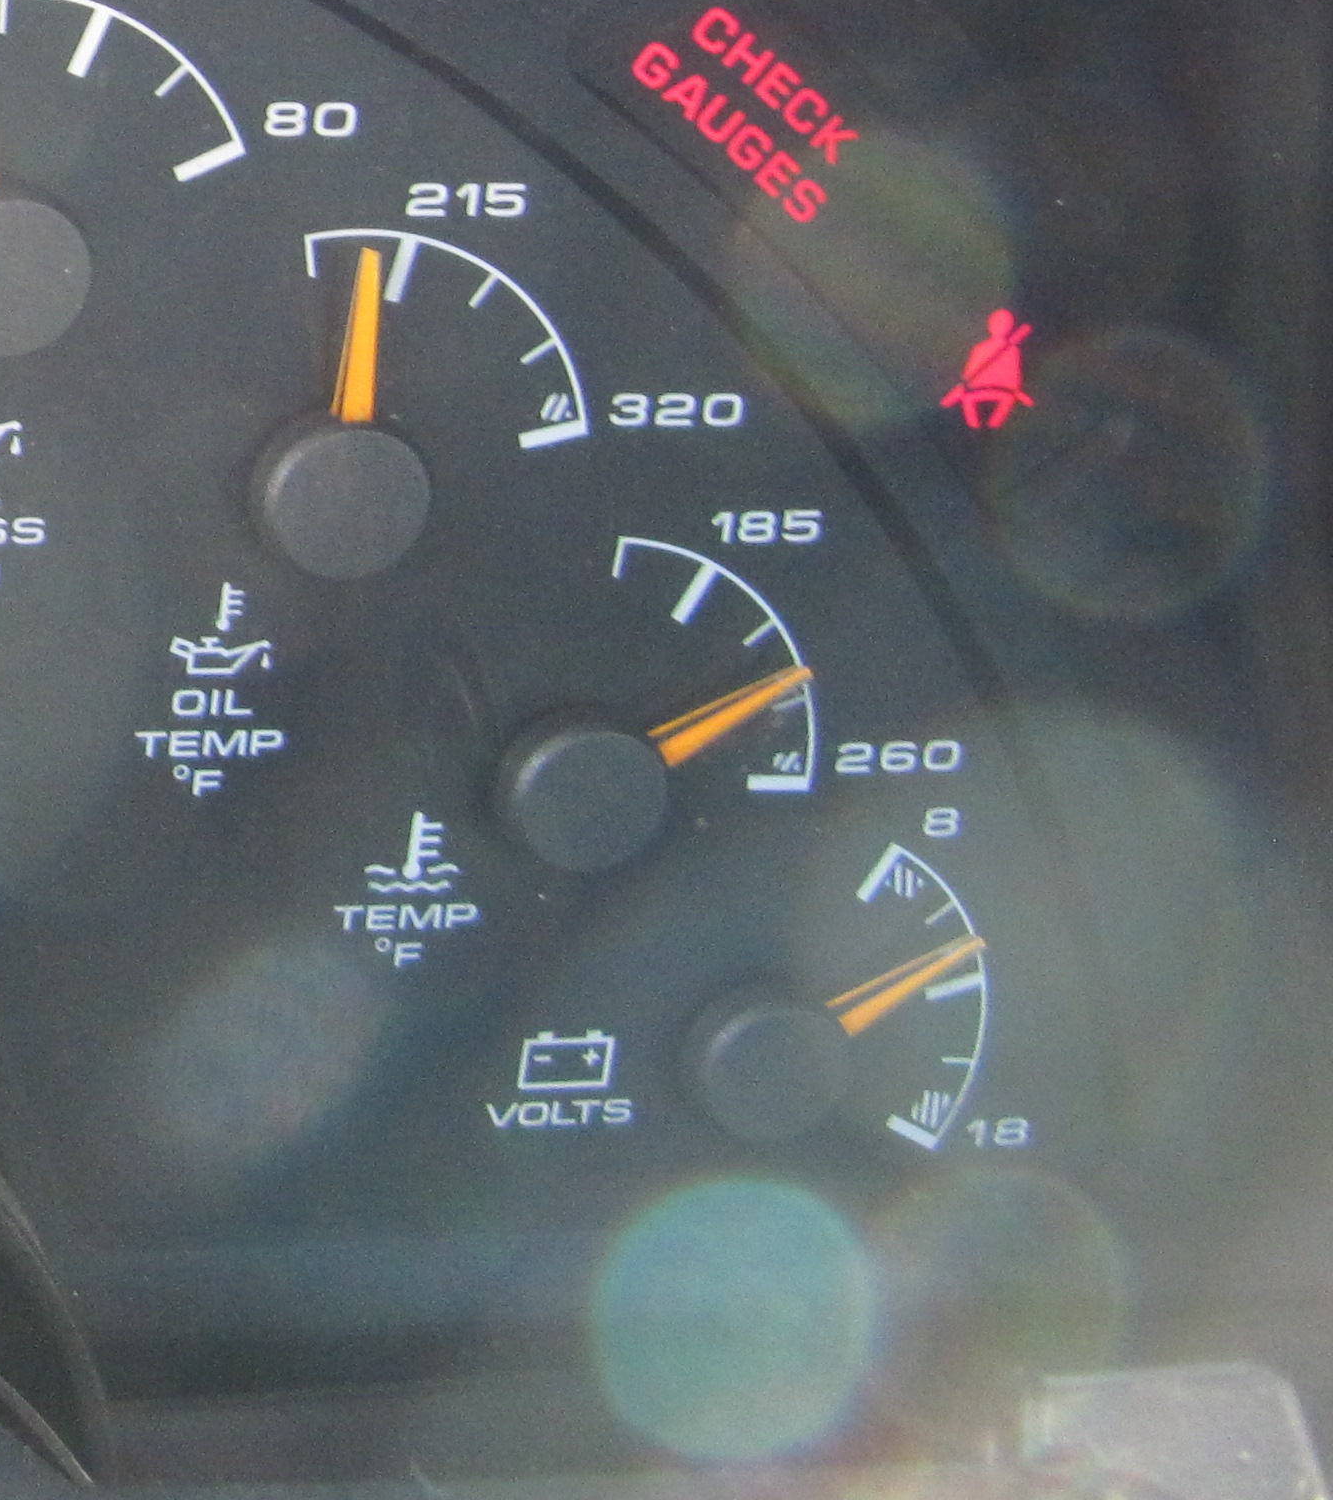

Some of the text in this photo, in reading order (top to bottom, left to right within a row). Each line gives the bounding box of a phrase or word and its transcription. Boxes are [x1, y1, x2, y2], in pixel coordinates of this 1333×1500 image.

[691, 5, 860, 166] CHECK
[263, 101, 358, 138] 80
[630, 40, 829, 223] GAUGES
[405, 181, 528, 218] 215
[608, 393, 745, 428] 320
[711, 509, 822, 544] 185
[171, 688, 253, 718] OIL
[134, 728, 285, 759] TEMP
[834, 739, 963, 775] 260
[923, 807, 961, 839] 8
[334, 902, 479, 932] TEMP
[486, 1098, 633, 1129] VOLTS
[966, 1117, 1031, 1148] 18
